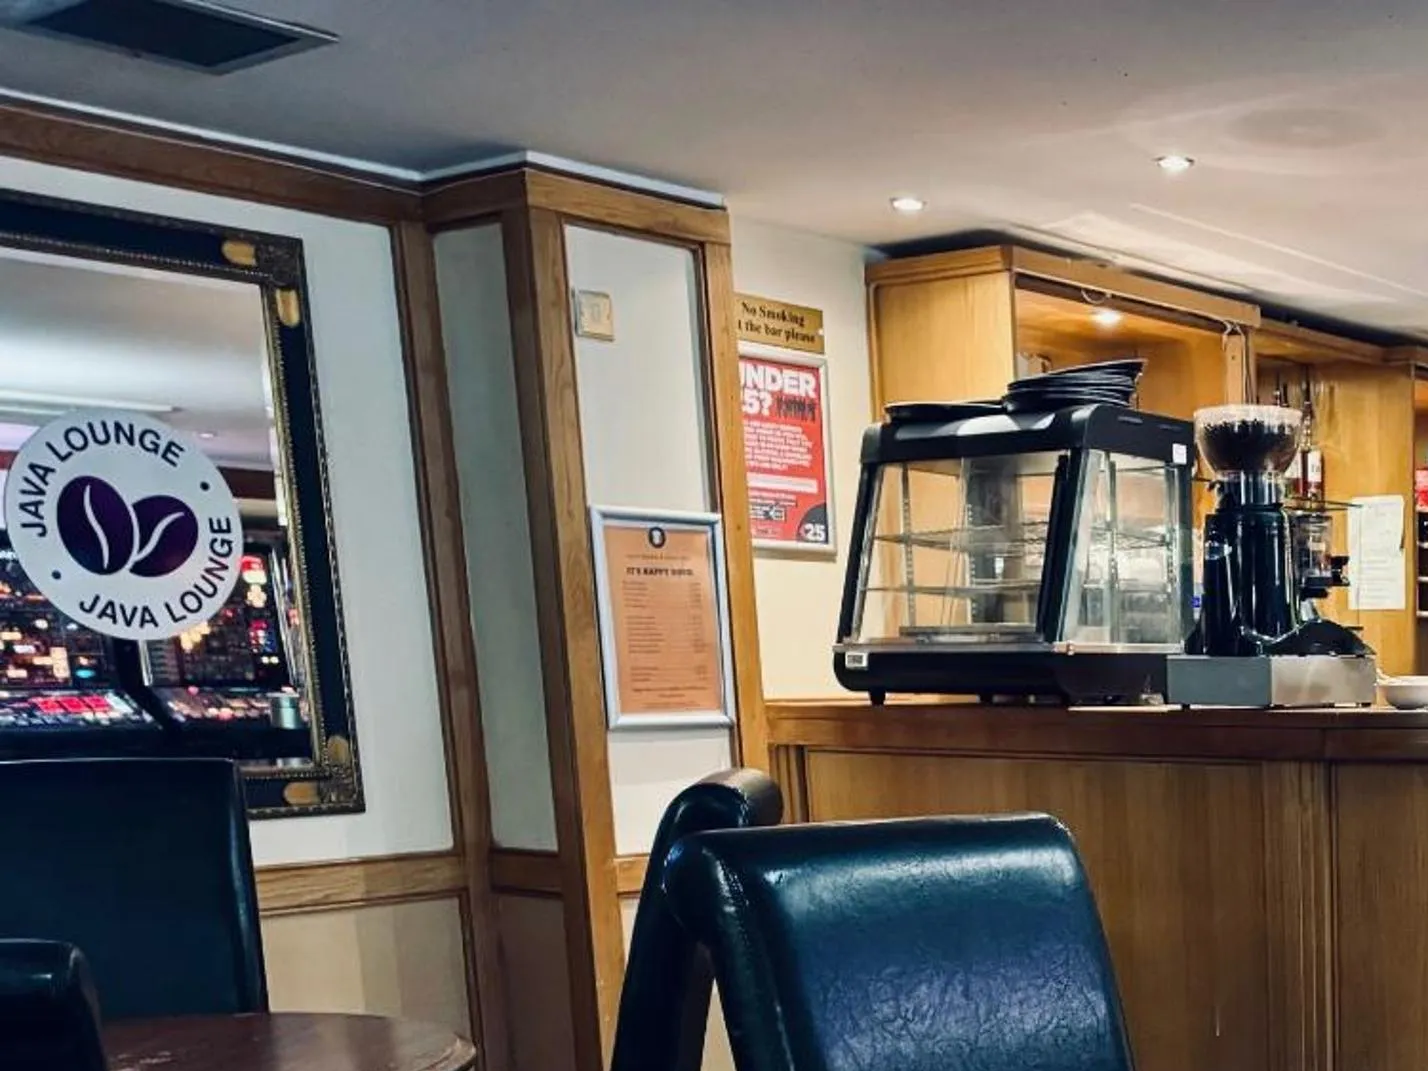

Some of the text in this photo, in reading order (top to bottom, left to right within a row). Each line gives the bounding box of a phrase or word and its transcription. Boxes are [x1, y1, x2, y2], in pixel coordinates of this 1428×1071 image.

[742, 301, 805, 328] No Smoking
[745, 319, 761, 334] the
[764, 323, 782, 337] bar
[784, 328, 816, 343] please
[742, 387, 773, 416] 5?
[19, 420, 185, 538] JAVA LOUNGE
[804, 523, 826, 541] 25
[79, 516, 232, 629] JAVA LOUNGE
